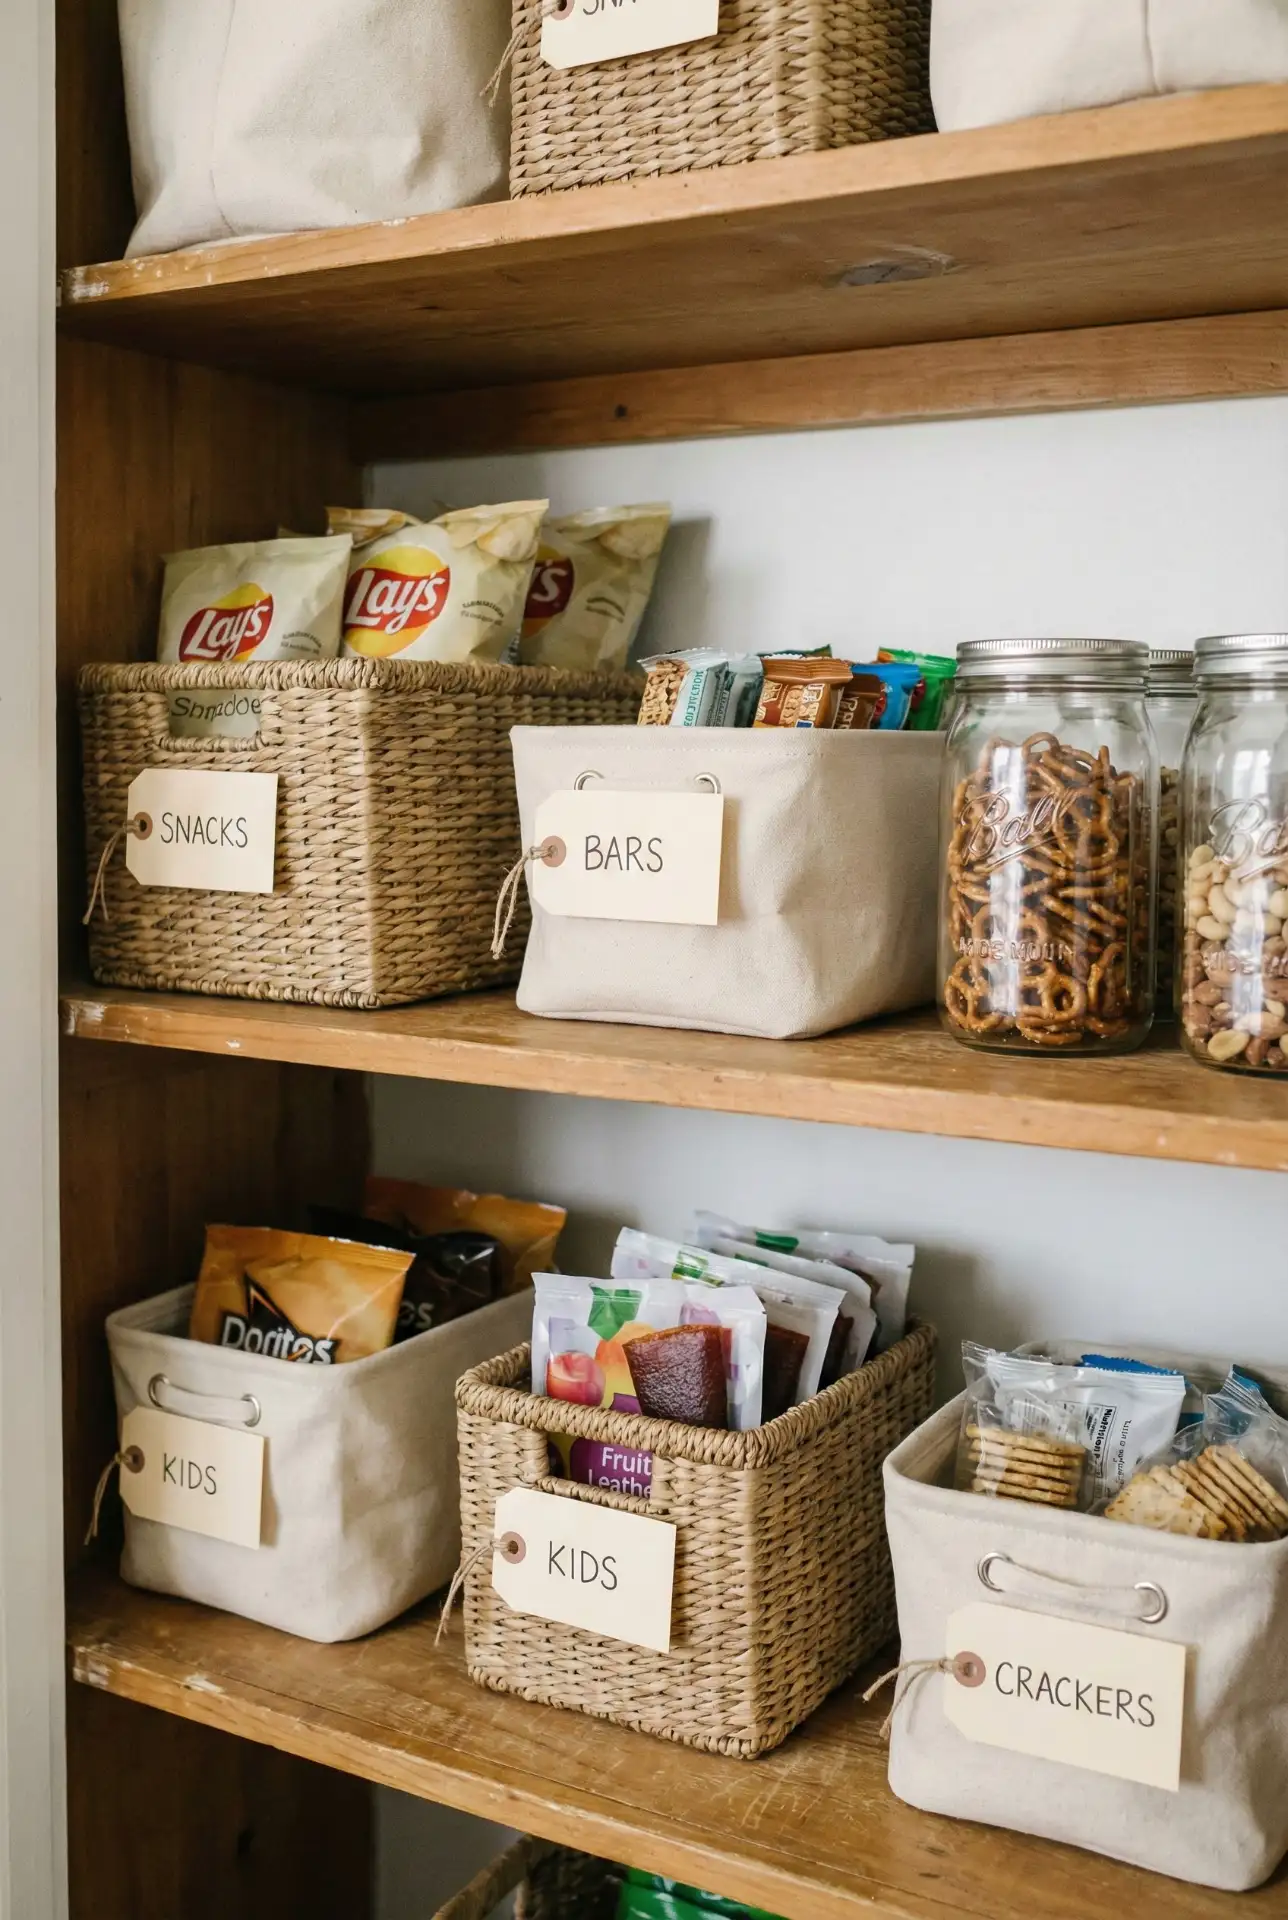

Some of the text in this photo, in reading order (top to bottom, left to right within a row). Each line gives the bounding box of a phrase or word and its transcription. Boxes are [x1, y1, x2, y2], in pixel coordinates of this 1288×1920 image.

[345, 571, 446, 635] Lay's
[184, 599, 271, 662] Lay's
[160, 811, 248, 848] SNACKS
[585, 834, 663, 873] BARS
[221, 1315, 335, 1364] Doritos
[163, 1452, 217, 1495] KIDS
[588, 1468, 652, 1498] Leathe
[602, 1446, 652, 1476] Fruit
[548, 1540, 617, 1590] KIDS
[995, 1661, 1155, 1727] CRACKERS
